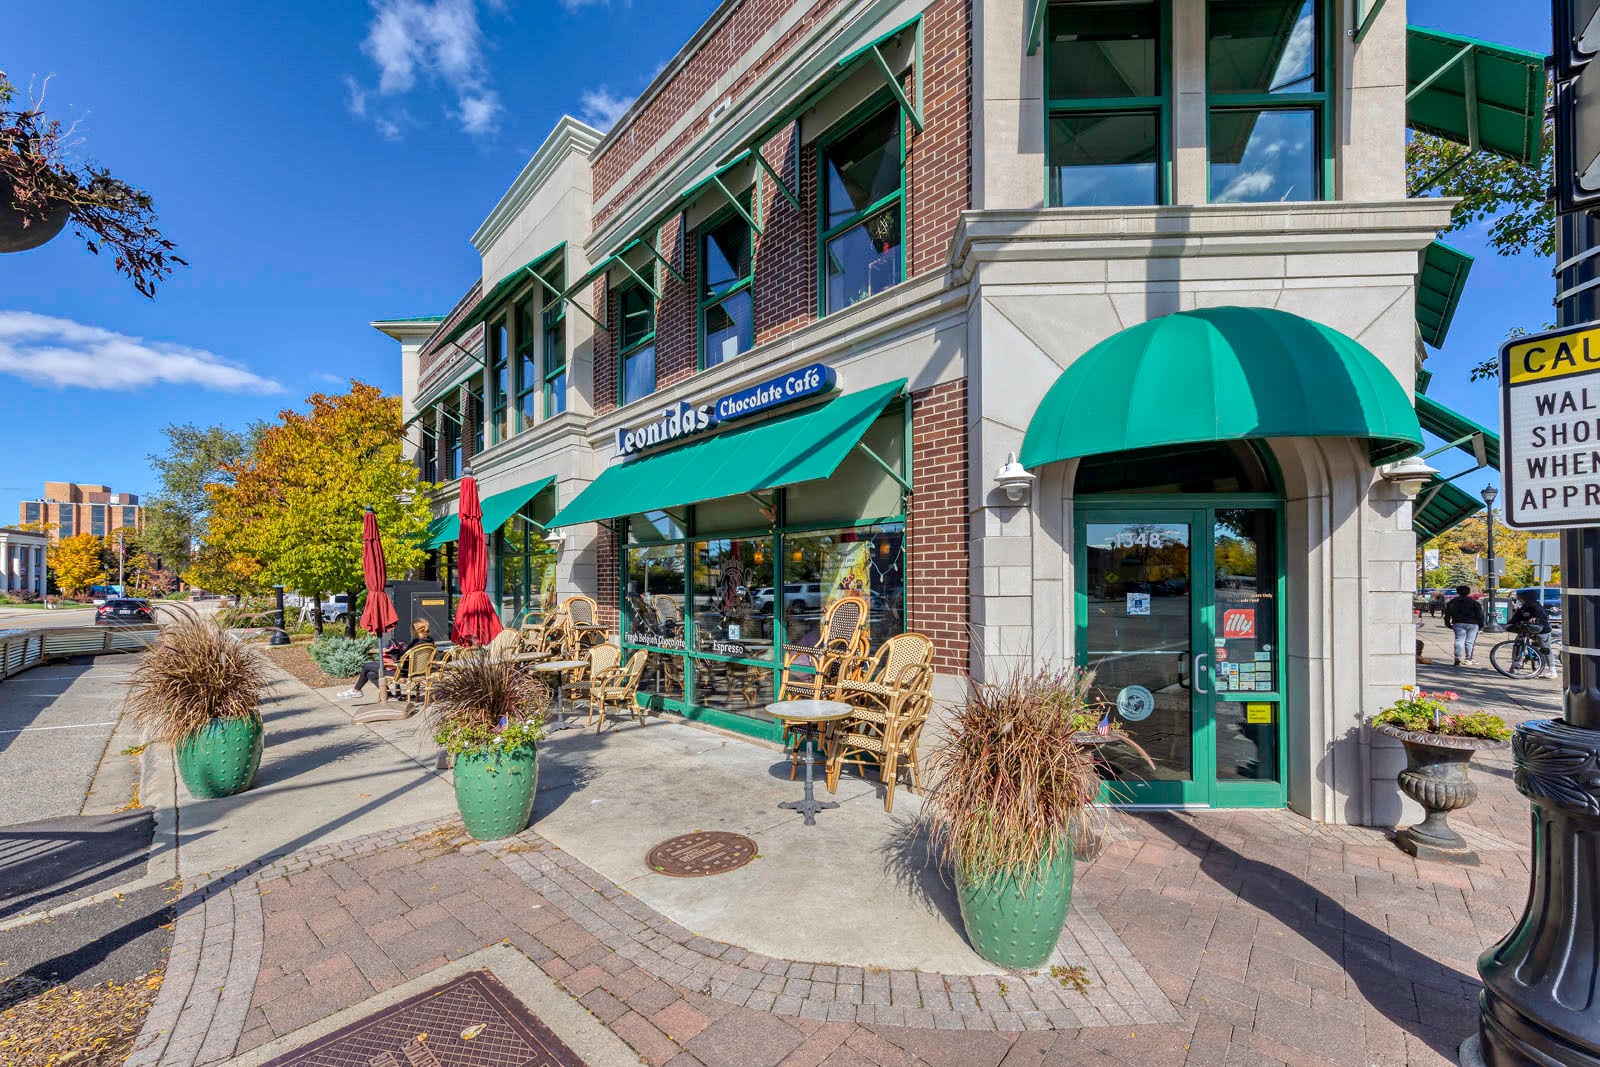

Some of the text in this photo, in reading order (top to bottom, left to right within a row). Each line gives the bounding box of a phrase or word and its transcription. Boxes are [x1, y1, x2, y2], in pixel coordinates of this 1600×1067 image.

[719, 367, 820, 417] Chocolate Café
[614, 401, 709, 457] Leonidas
[1531, 417, 1600, 448] SHO
[1115, 532, 1161, 549] 1348
[1225, 613, 1253, 635] illy
[712, 640, 744, 655] Espresso
